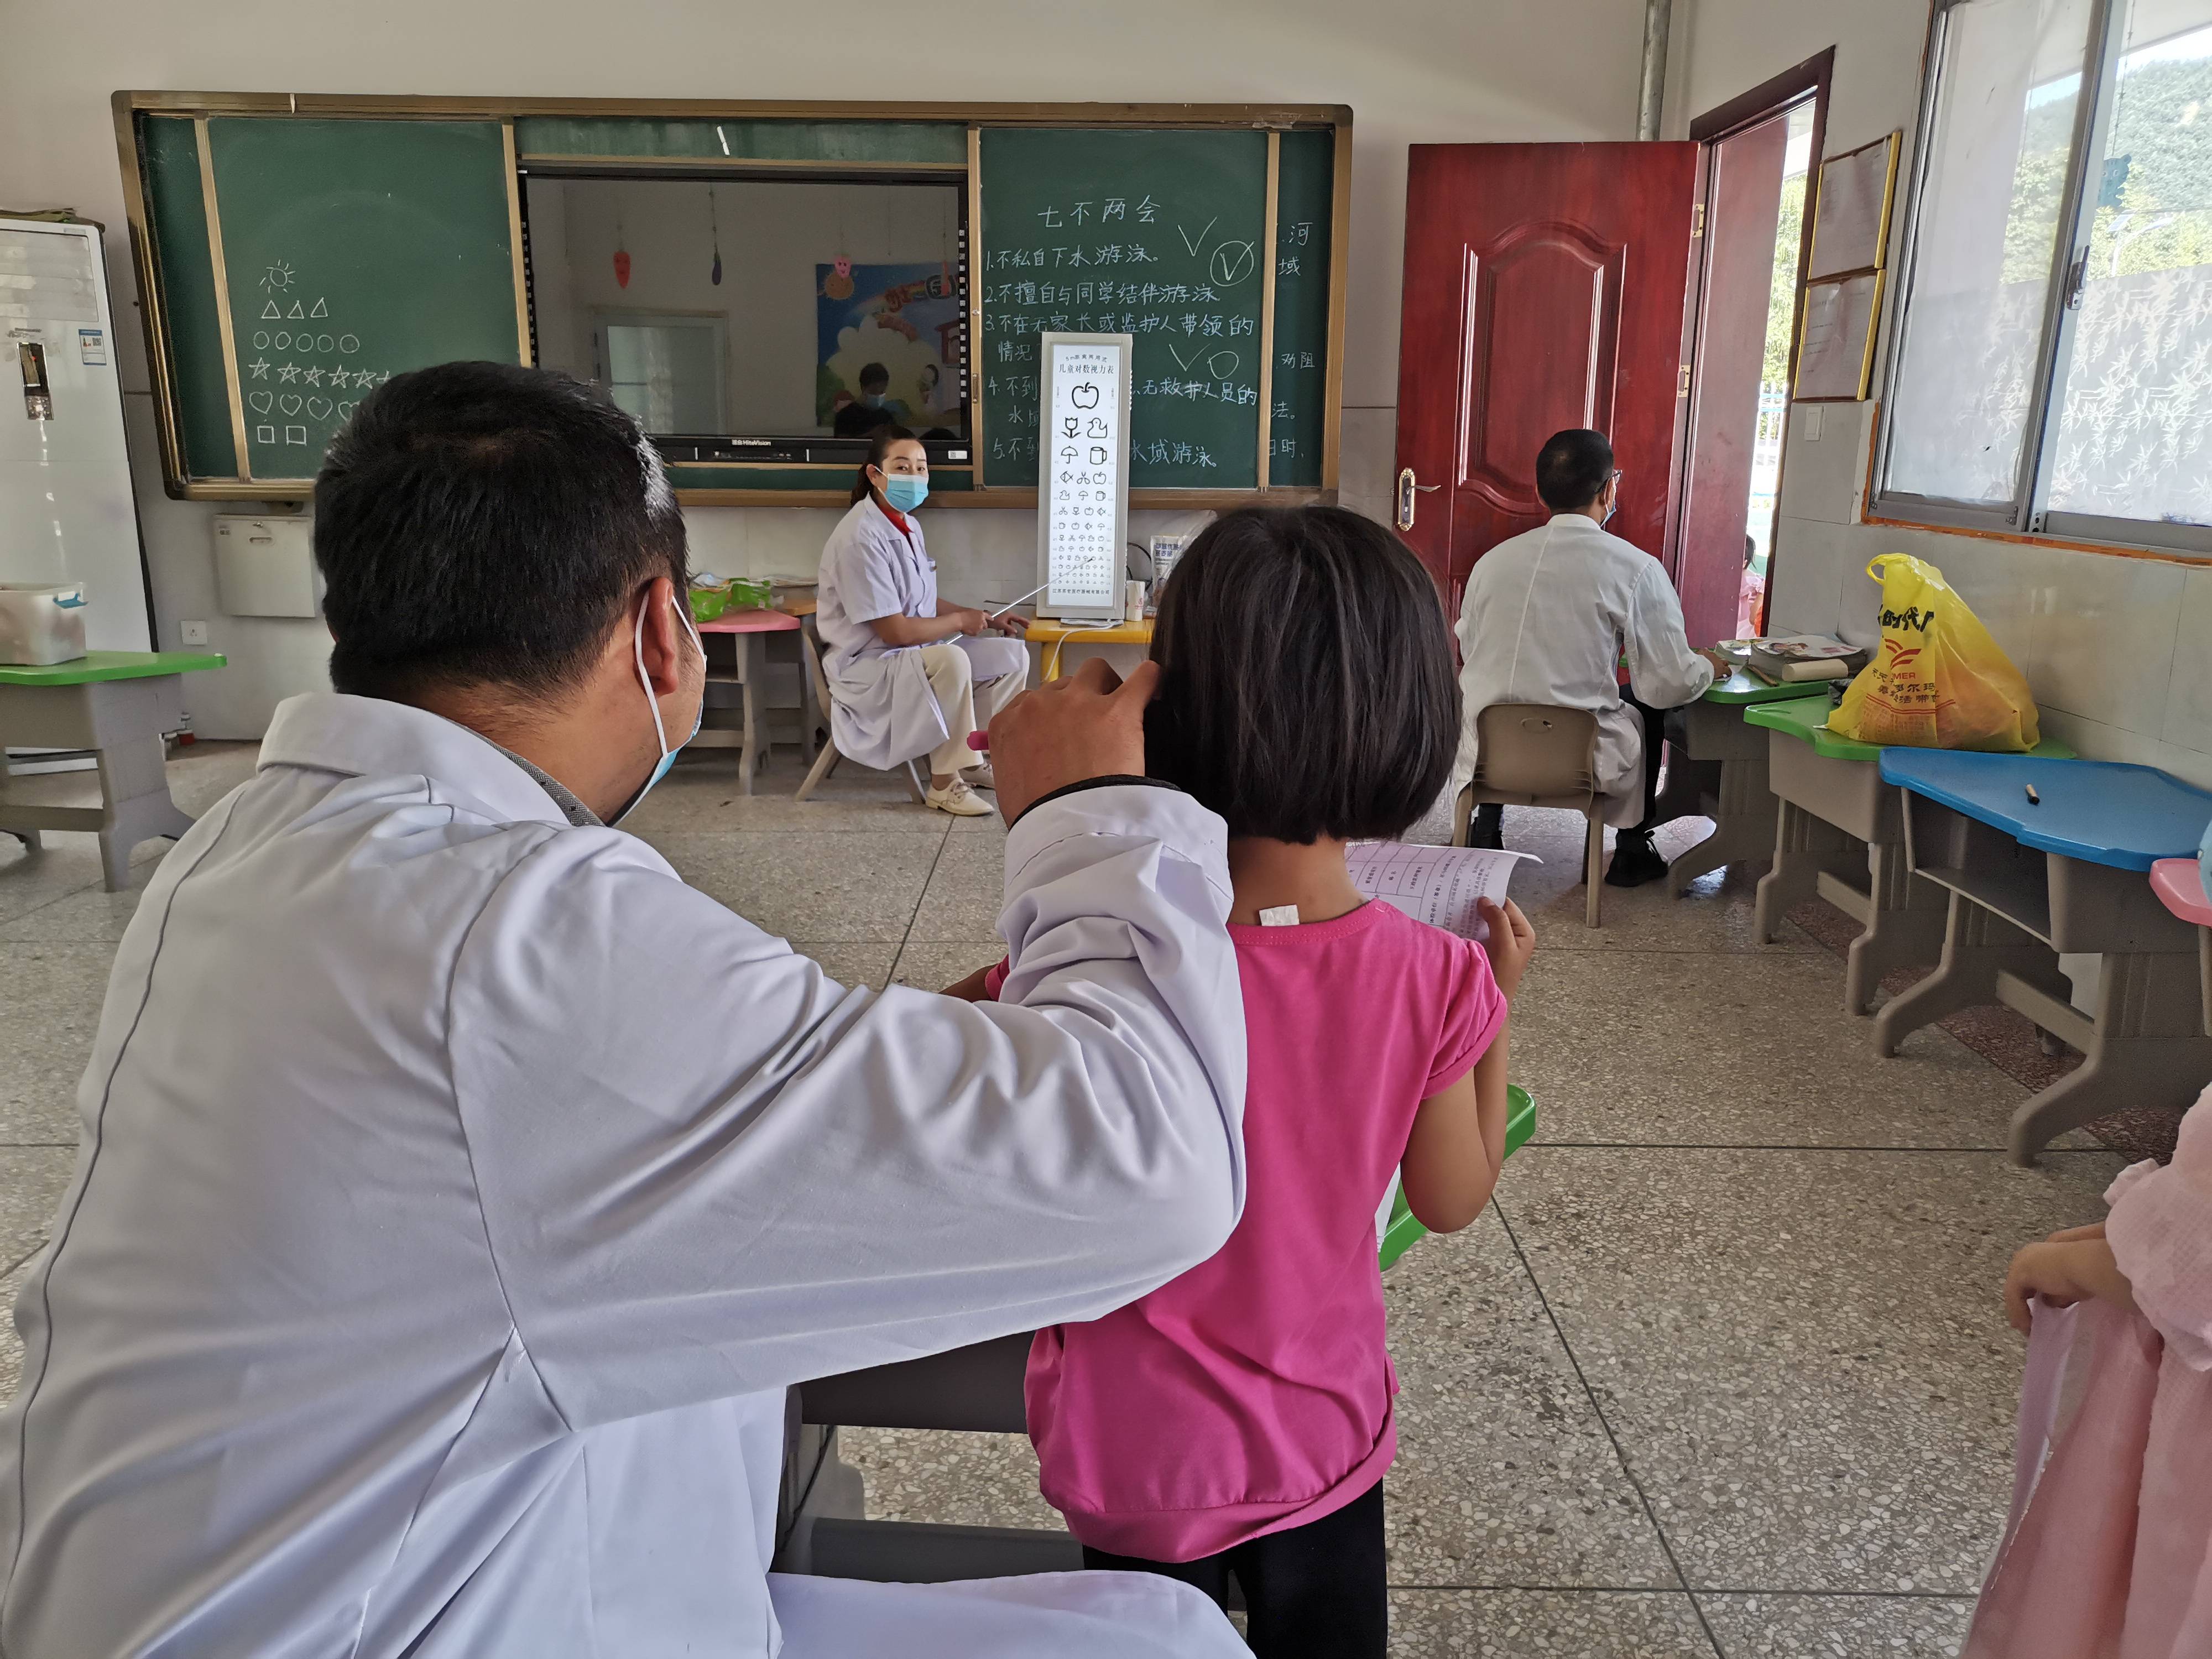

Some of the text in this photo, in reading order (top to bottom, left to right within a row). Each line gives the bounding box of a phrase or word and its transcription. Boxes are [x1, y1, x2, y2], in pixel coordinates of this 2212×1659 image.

[1037, 195, 1161, 227] 七不两会
[1278, 256, 1301, 276] 域
[998, 340, 1041, 363] 情况
[1877, 604, 1934, 633] 时代
